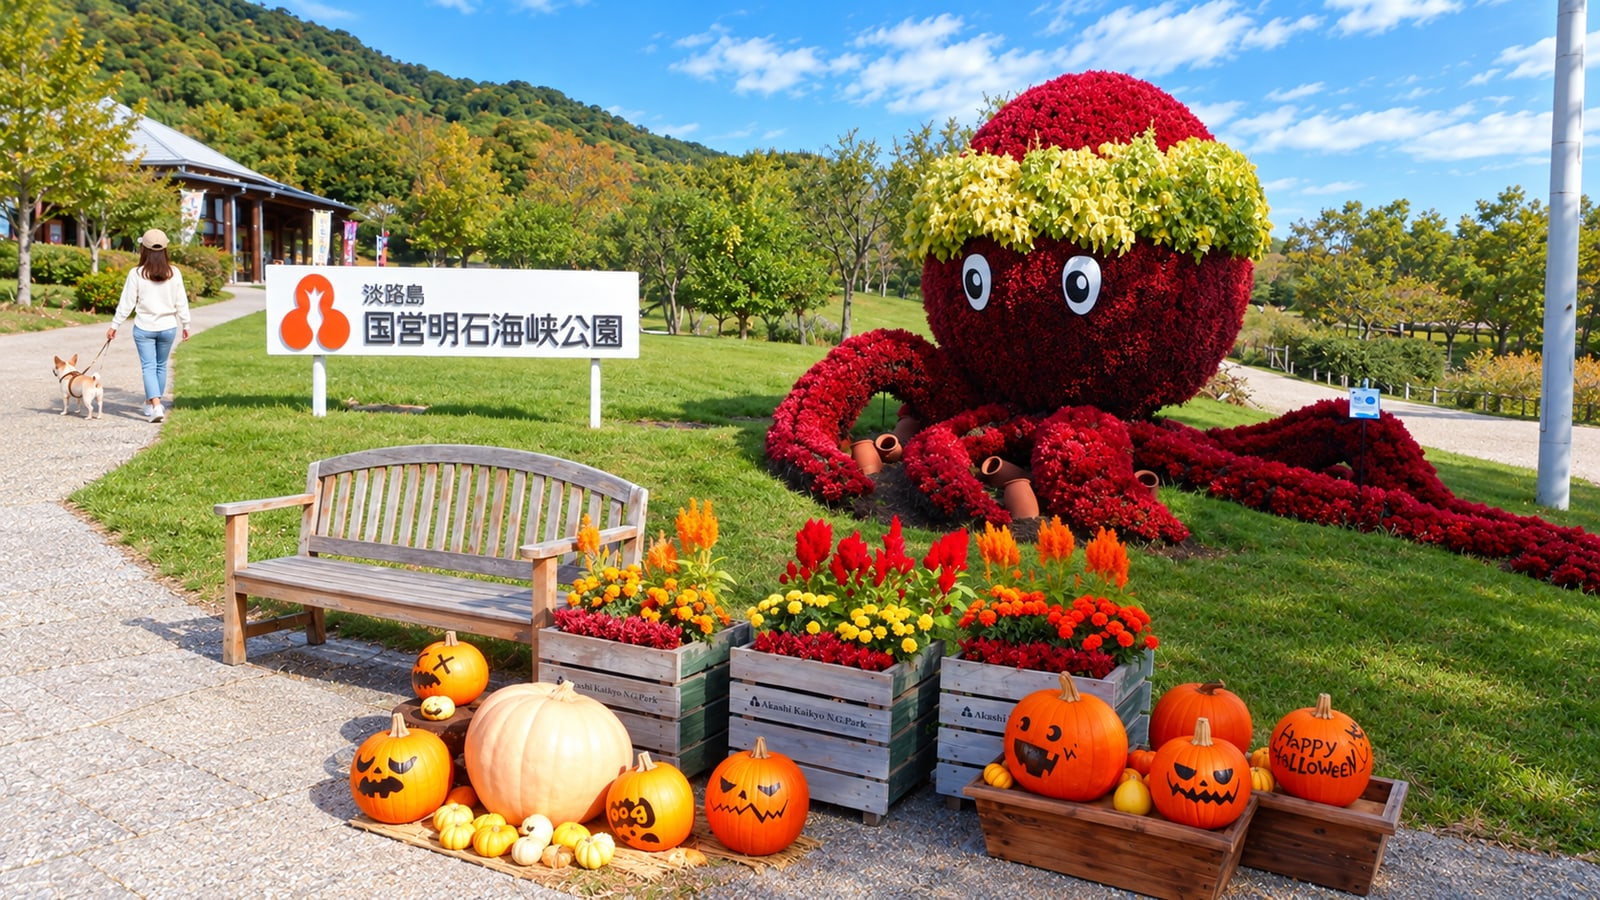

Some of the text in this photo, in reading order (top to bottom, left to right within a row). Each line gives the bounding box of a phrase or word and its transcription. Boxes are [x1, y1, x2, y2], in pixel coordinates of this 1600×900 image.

[362, 283, 425, 306] 淡路島
[364, 311, 623, 348] 国営明石海峡公園
[761, 700, 791, 713] Akashi
[794, 706, 825, 720] Kaikyo
[974, 711, 1006, 722] Akashi
